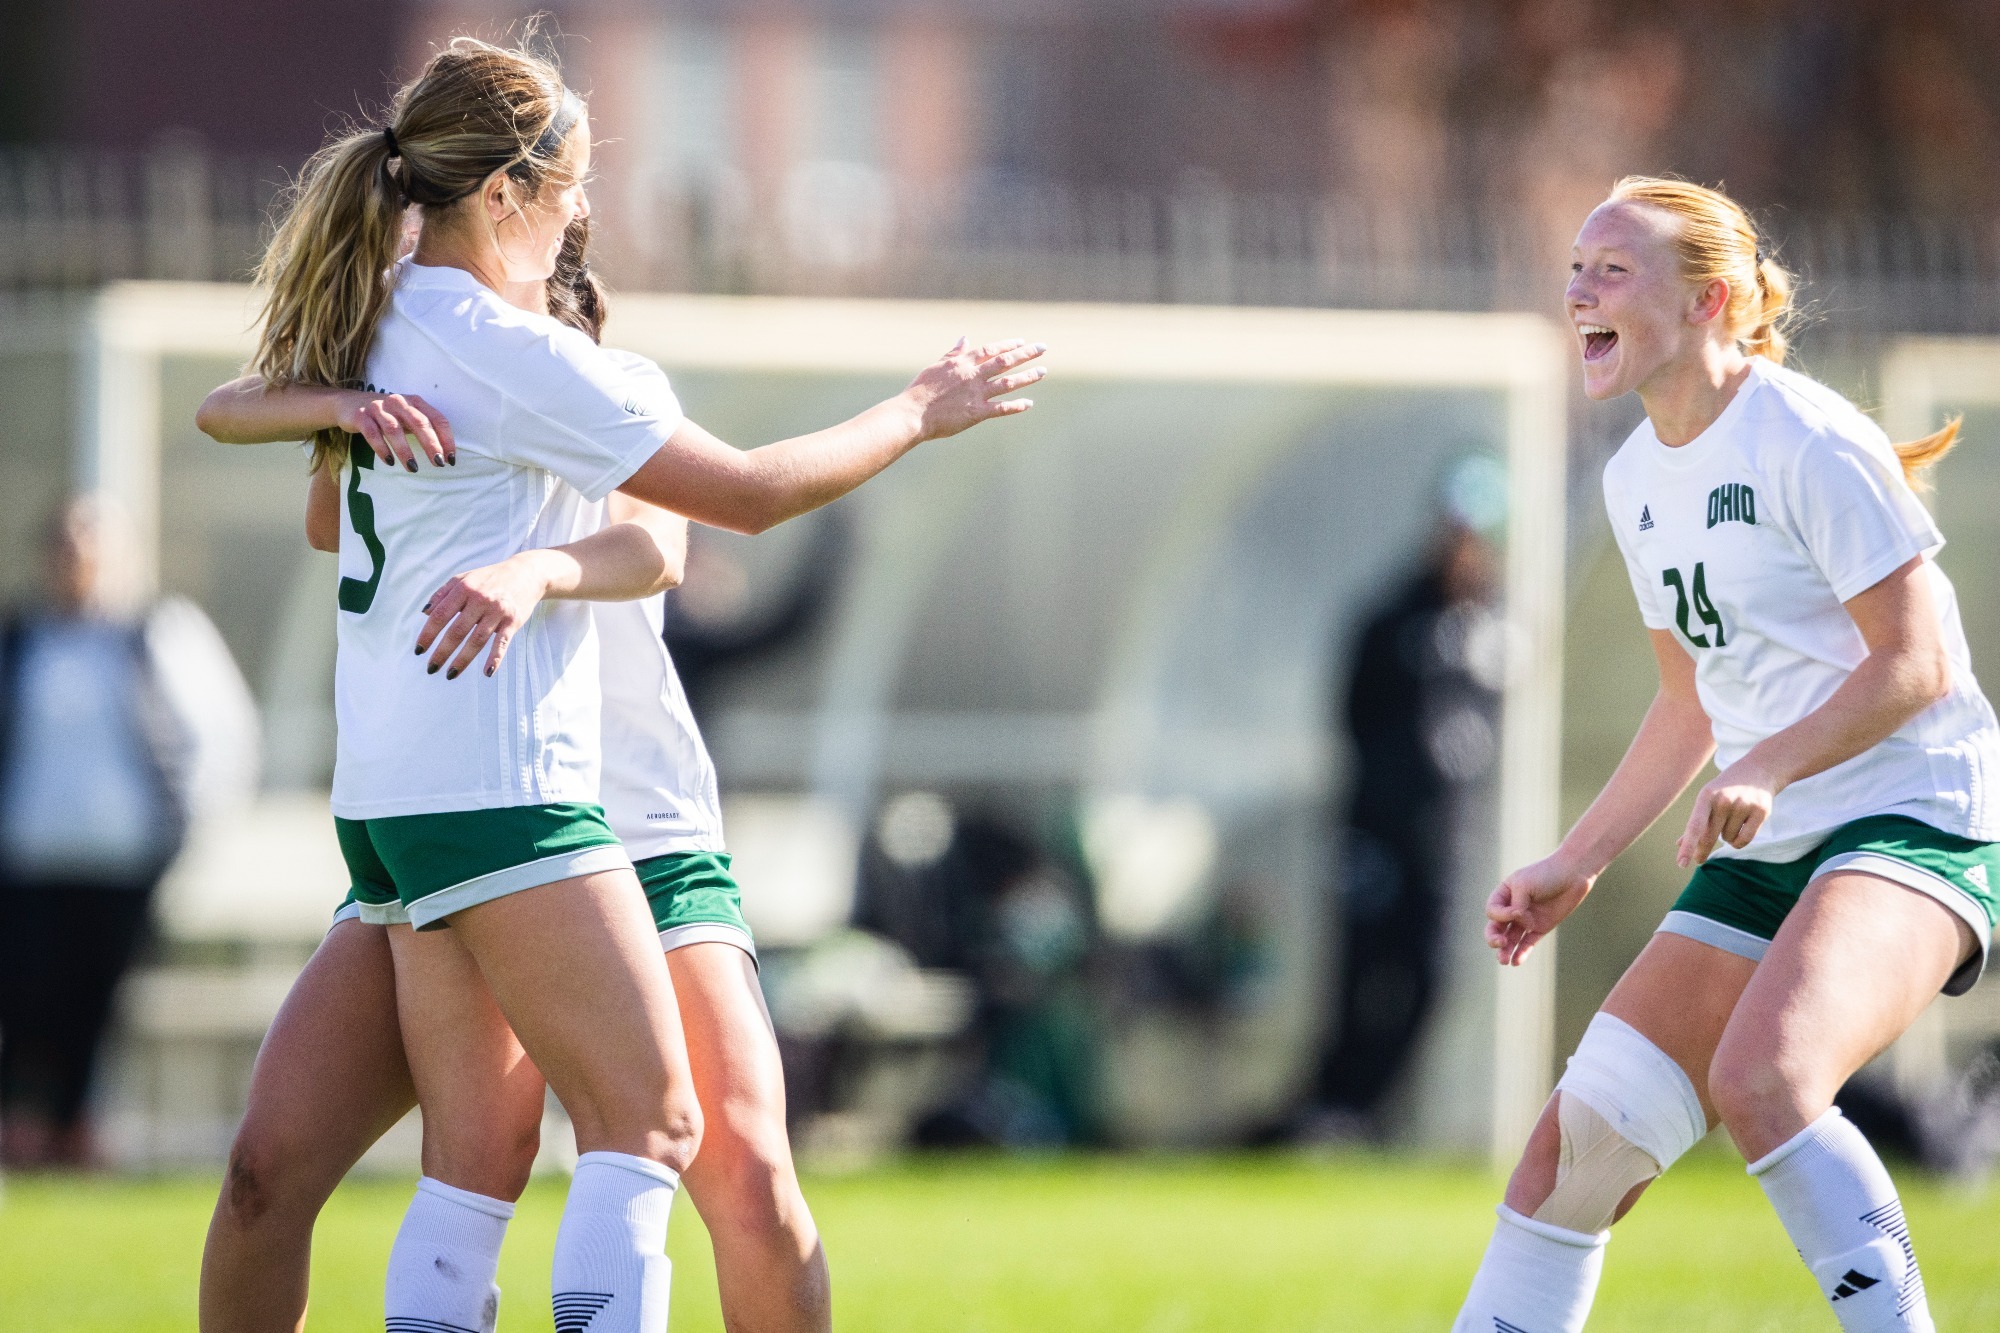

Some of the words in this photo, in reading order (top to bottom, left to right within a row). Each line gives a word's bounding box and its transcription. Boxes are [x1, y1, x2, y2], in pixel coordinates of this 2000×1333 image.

[338, 433, 386, 614] 5
[1707, 483, 1756, 529] OHIO
[1662, 562, 1727, 647] 24
[646, 812, 680, 820] AEROREADY
